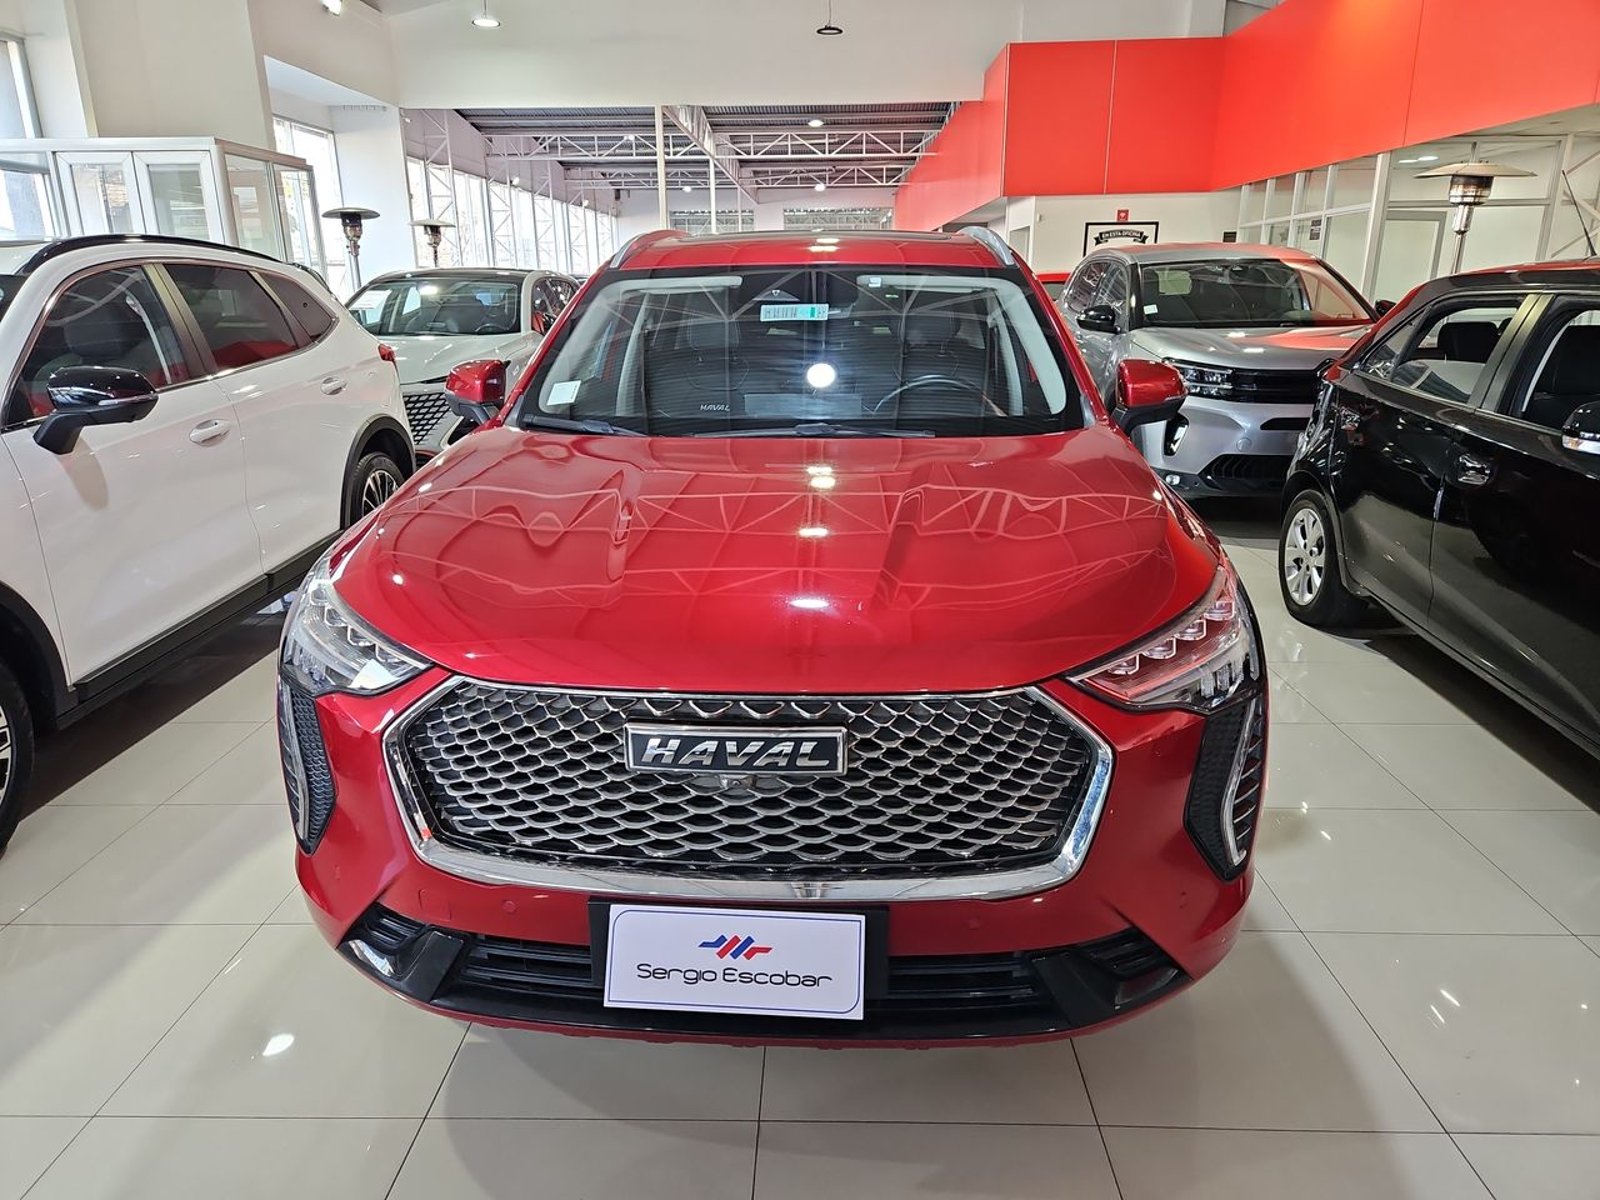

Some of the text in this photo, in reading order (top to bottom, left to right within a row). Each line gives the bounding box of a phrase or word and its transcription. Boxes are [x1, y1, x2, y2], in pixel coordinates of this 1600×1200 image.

[700, 404, 731, 412] HAVAL
[641, 738, 830, 767] HAVAL
[636, 963, 833, 987] Sergio Escobar
